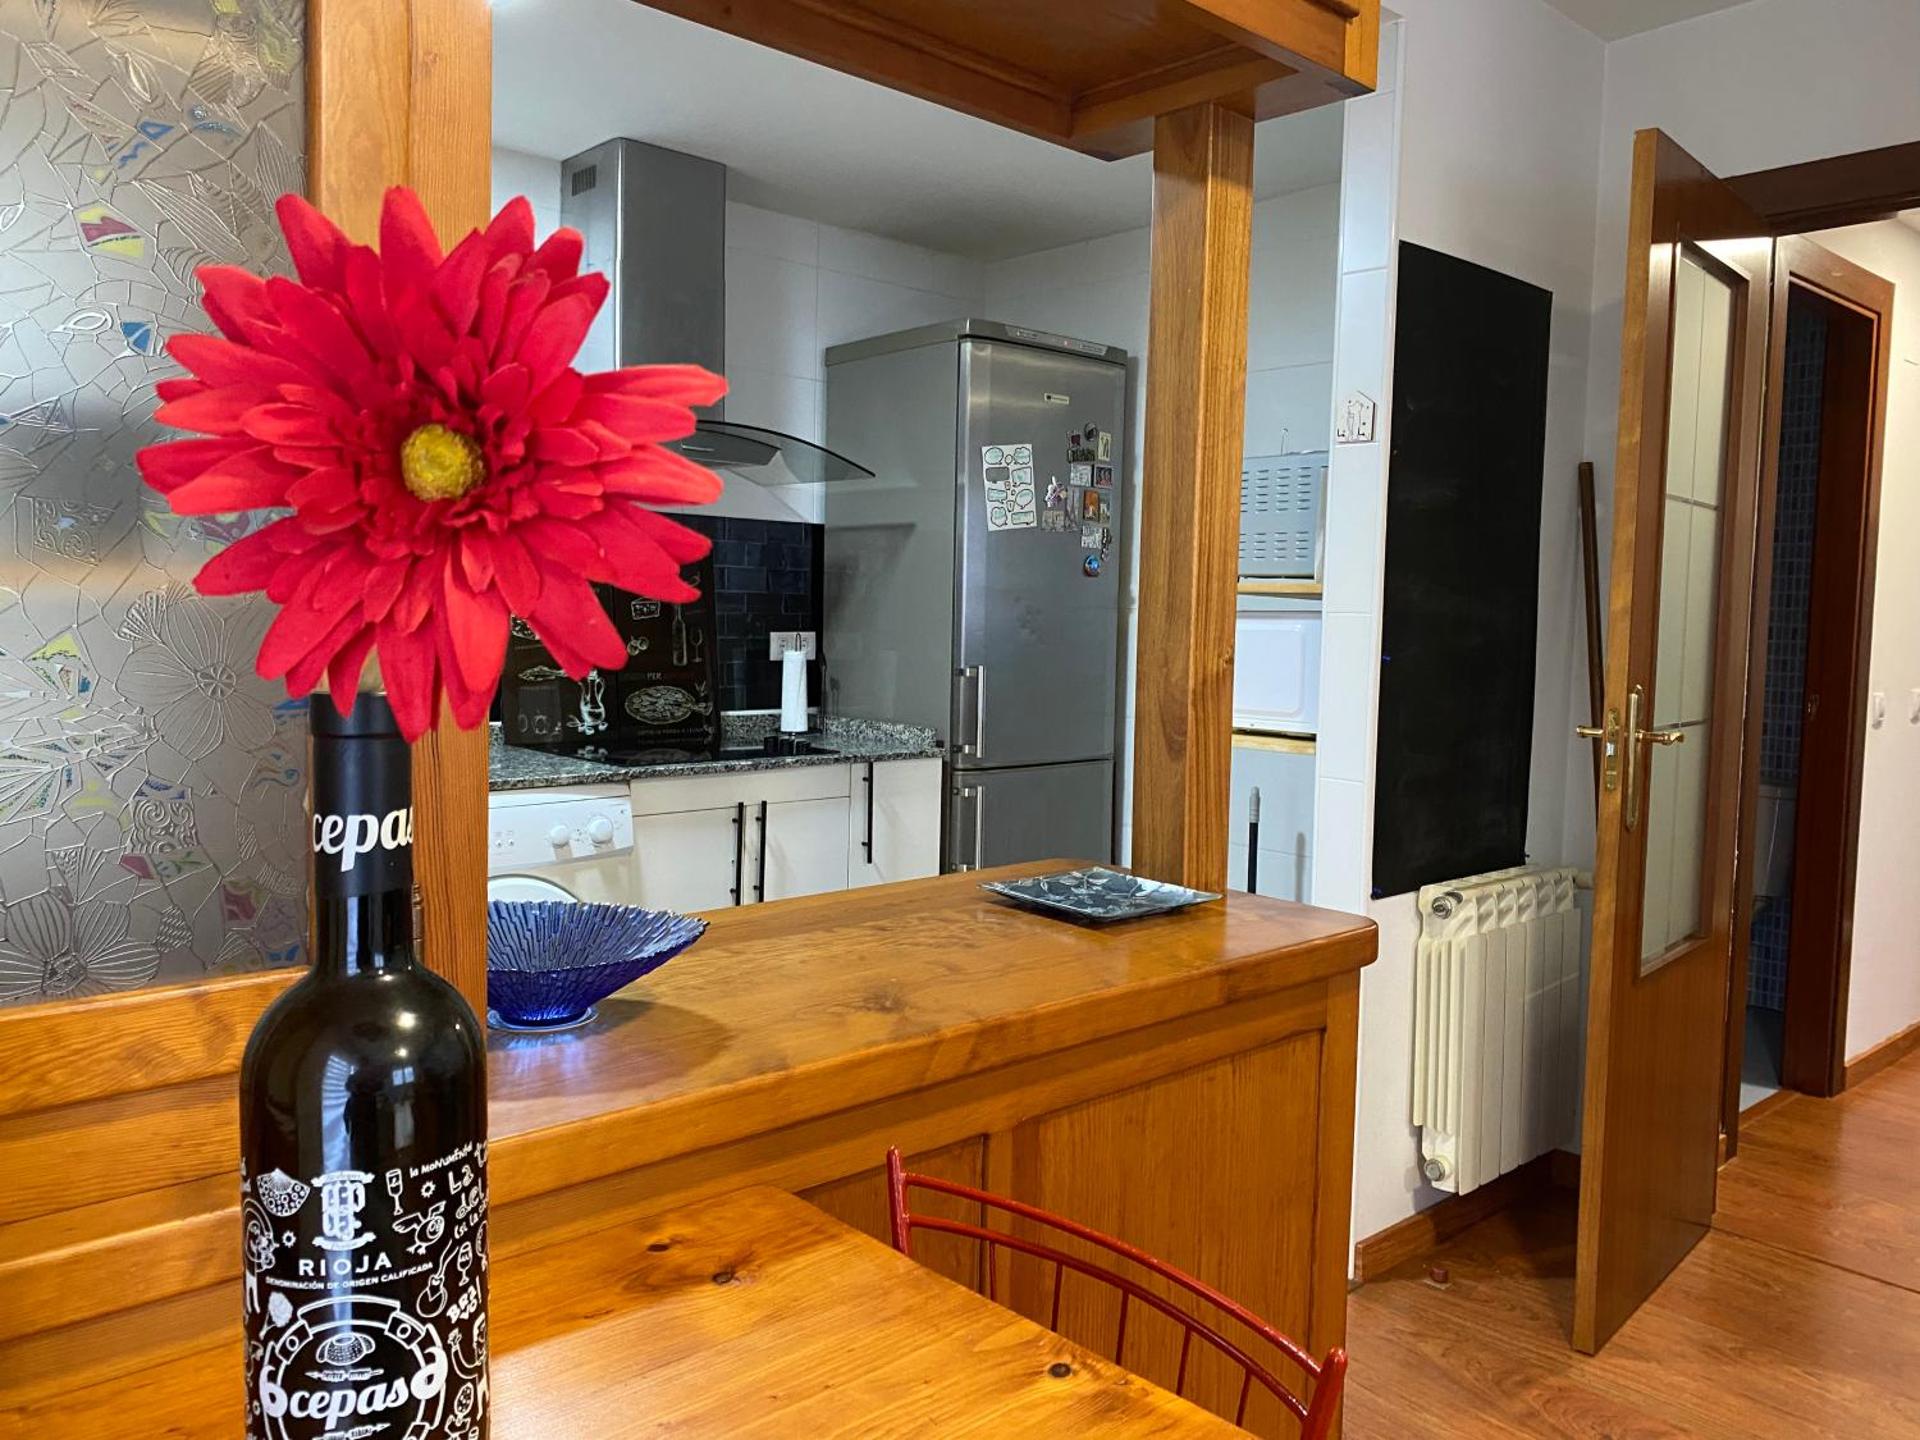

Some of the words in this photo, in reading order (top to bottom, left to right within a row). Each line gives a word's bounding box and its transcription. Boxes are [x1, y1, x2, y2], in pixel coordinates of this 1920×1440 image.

[298, 1251, 392, 1277] RIOJA
[327, 1281, 340, 1290] DE
[342, 1276, 379, 1289] ORIGEN
[381, 1261, 434, 1283] CALIFICADA
[289, 1377, 409, 1431] cepas
